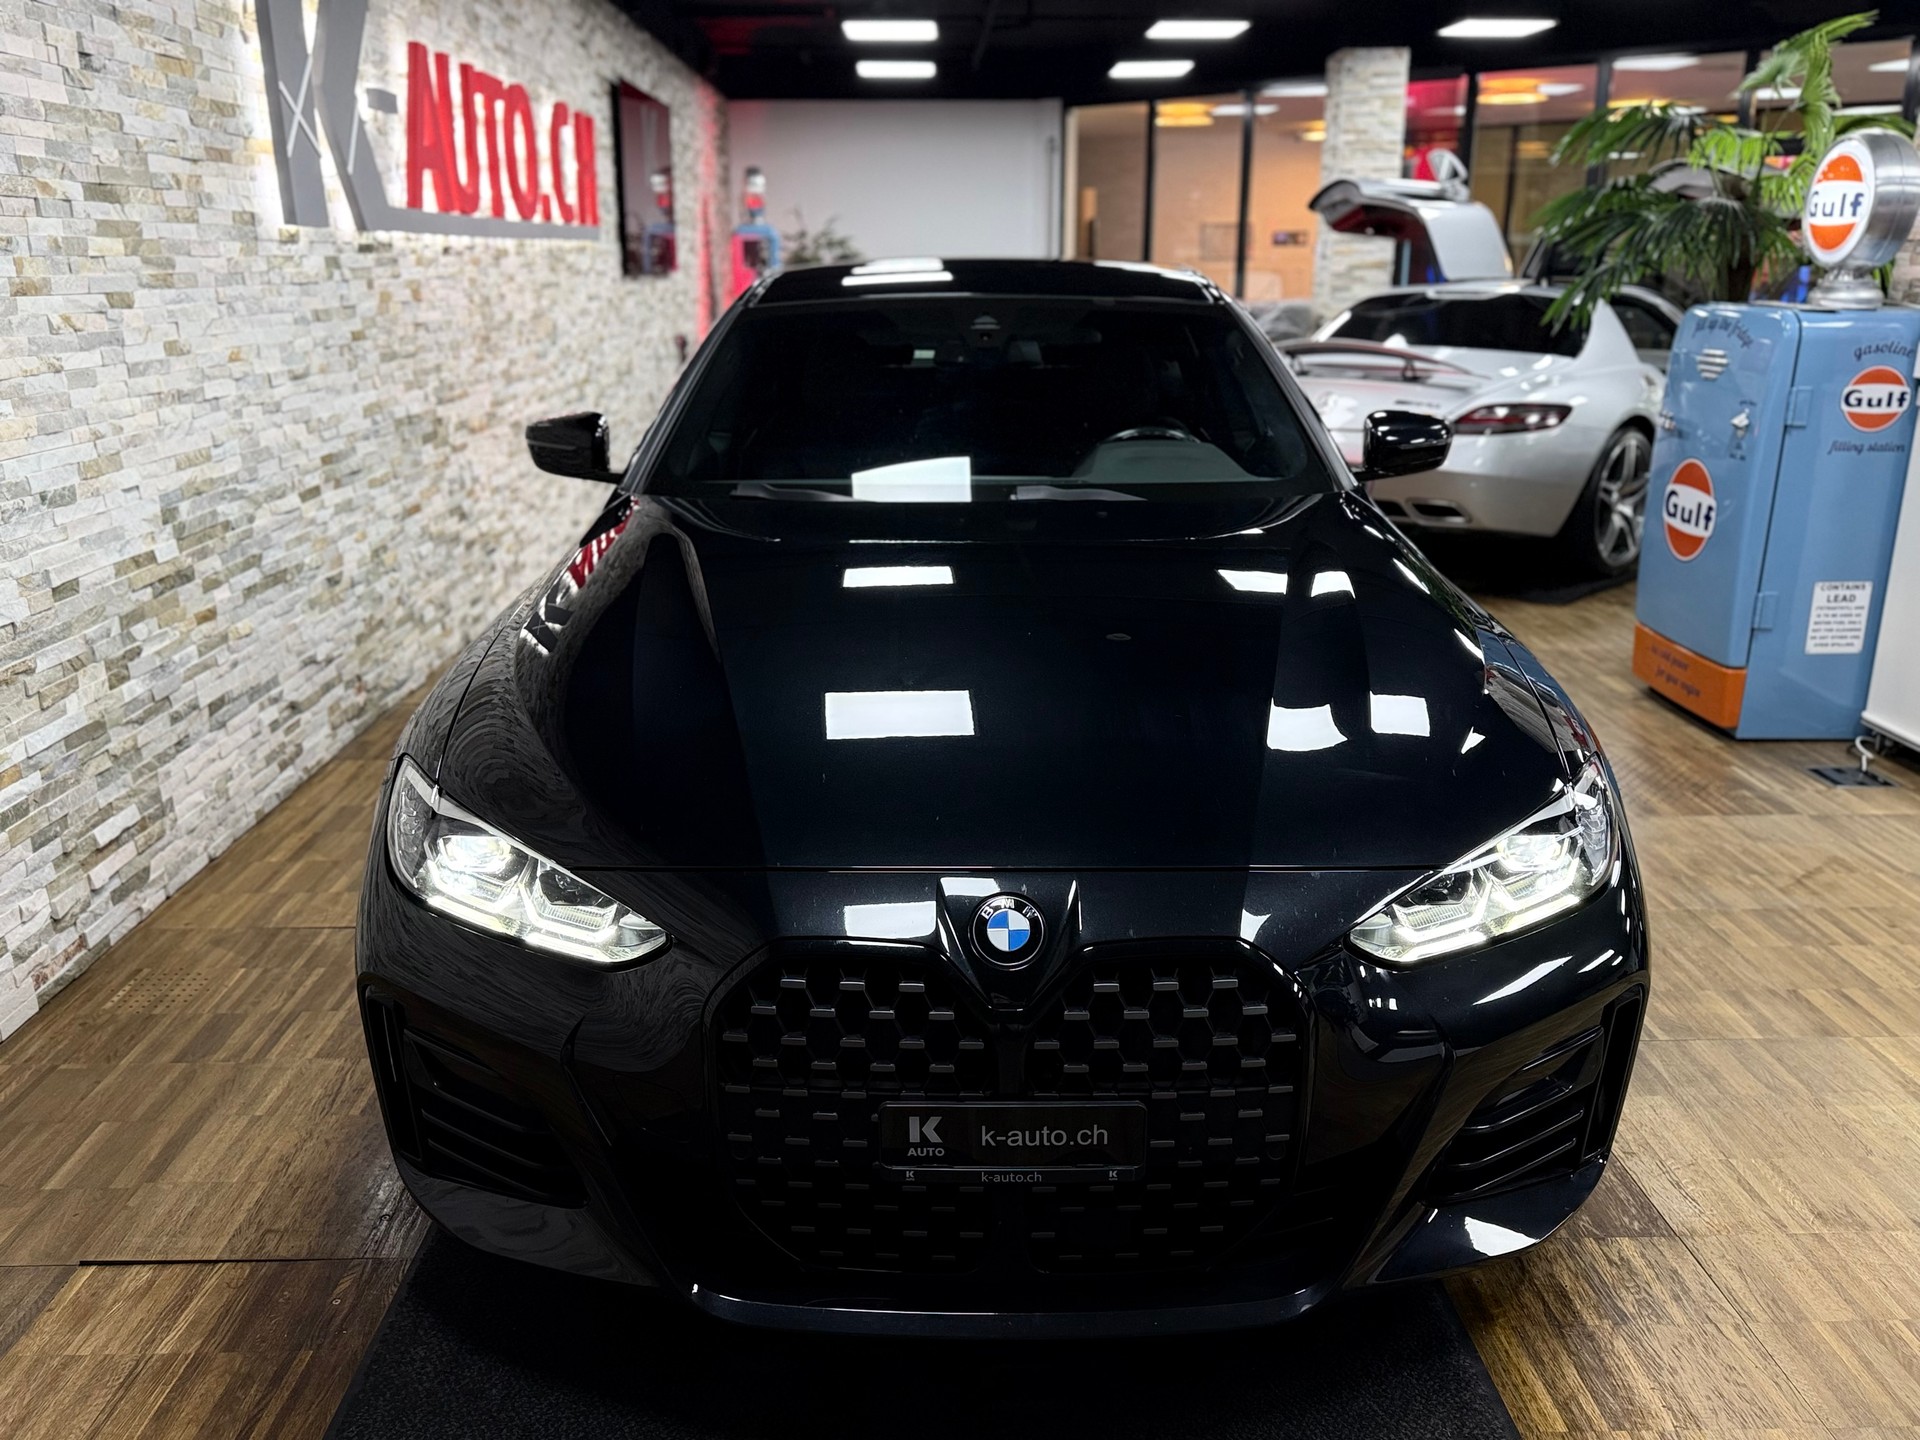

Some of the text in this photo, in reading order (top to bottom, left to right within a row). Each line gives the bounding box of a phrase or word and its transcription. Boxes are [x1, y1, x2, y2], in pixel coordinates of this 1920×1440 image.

[1809, 190, 1864, 217] Gulf
[1854, 341, 1916, 361] gasoline
[1844, 389, 1909, 408] Gulf
[1827, 440, 1865, 456] filling
[1665, 489, 1714, 532] Gulf
[1820, 583, 1866, 592] CONTAINS
[1826, 594, 1857, 604] LEAD
[980, 898, 1038, 920] BMW
[909, 1116, 943, 1143] K
[981, 1125, 1108, 1146] k-auto.ch
[907, 1147, 945, 1157] AUTO
[981, 1171, 1042, 1182] k-auto.ch
